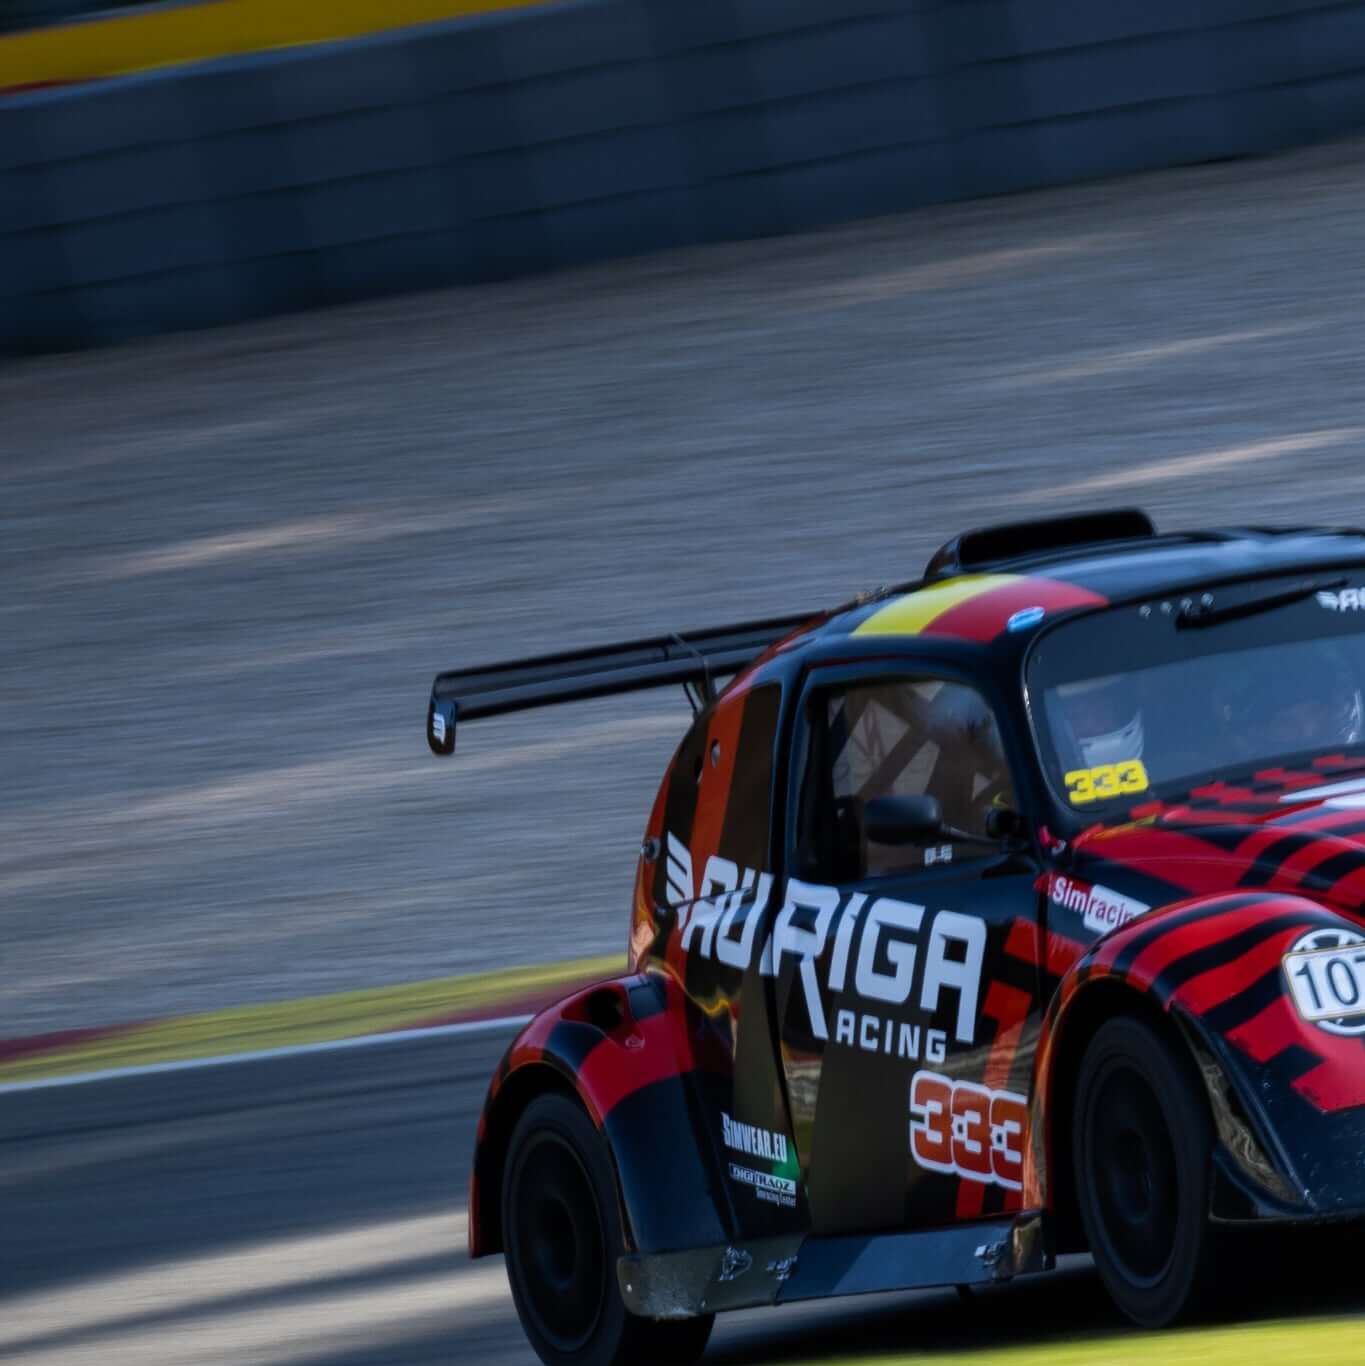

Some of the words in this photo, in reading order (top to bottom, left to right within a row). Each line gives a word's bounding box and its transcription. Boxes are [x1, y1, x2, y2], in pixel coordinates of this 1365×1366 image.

[1064, 759, 1149, 804] 333
[680, 855, 987, 1045] AURIGA
[910, 1069, 1028, 1190] 333
